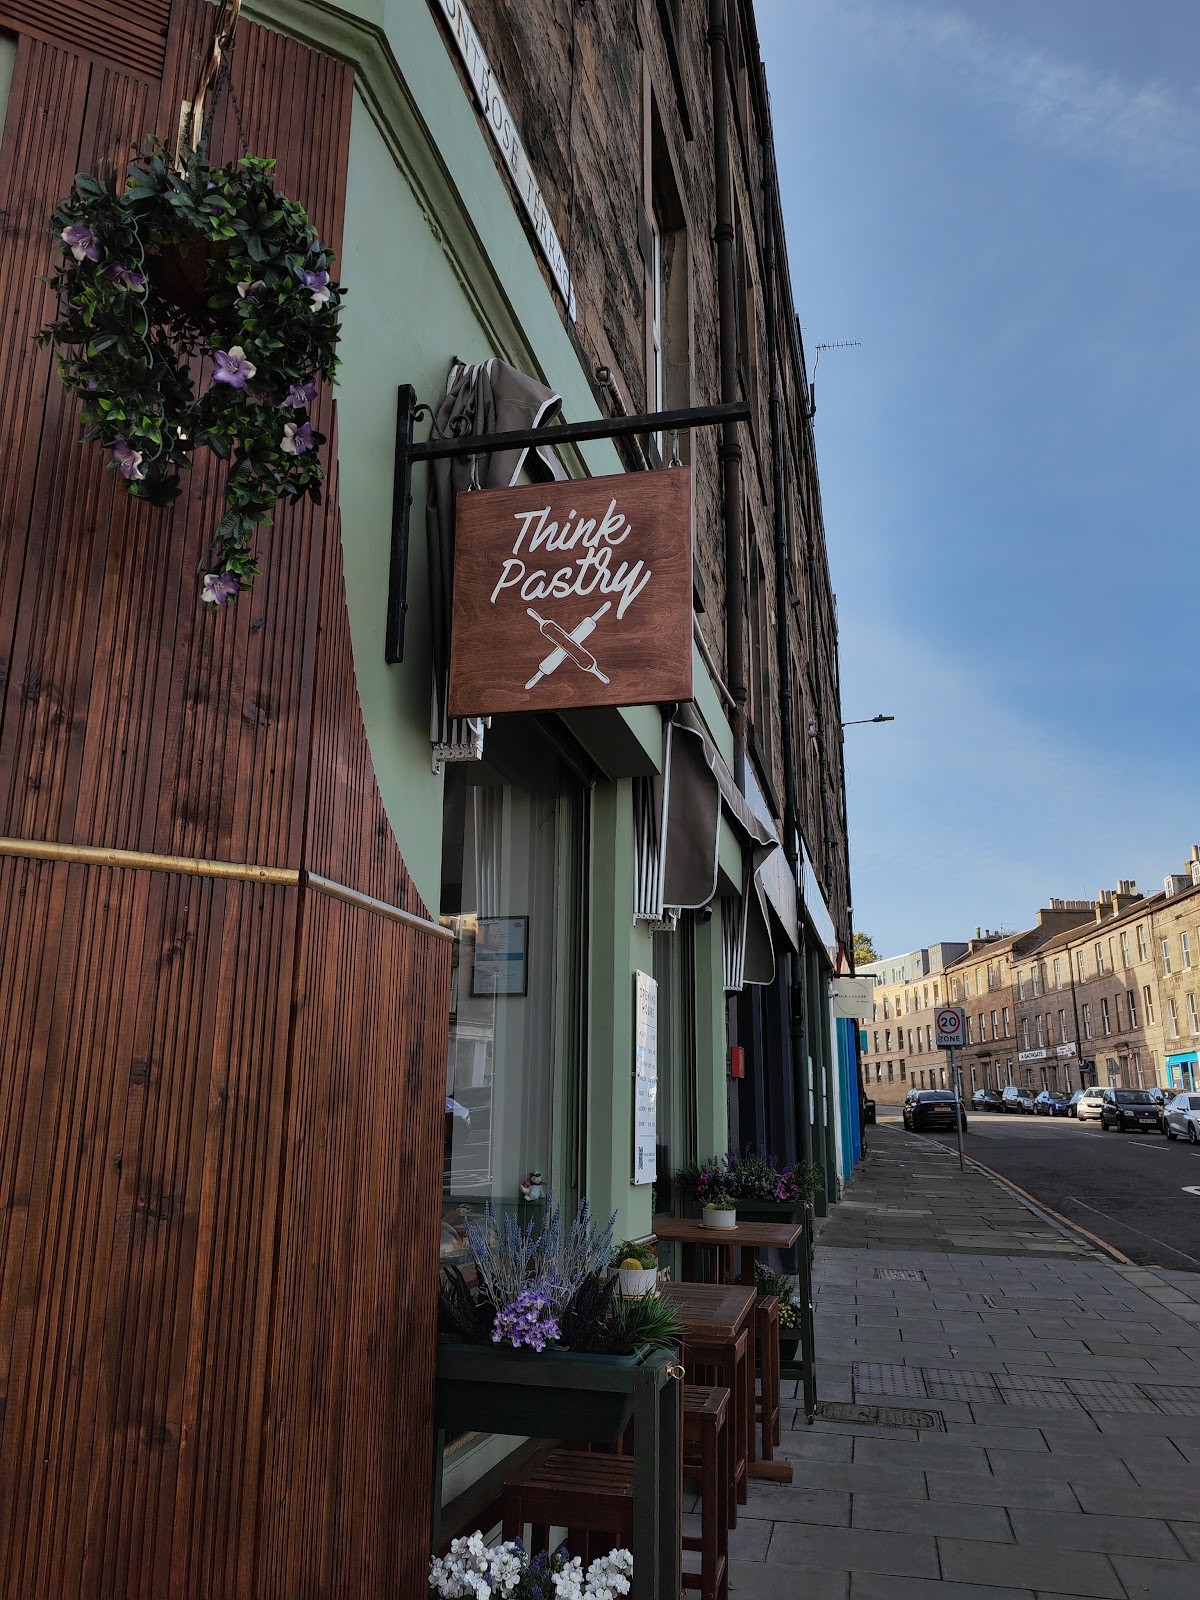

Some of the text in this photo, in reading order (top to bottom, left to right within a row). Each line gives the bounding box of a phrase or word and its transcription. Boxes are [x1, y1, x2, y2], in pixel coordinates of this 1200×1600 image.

[513, 498, 632, 555] Think
[490, 547, 651, 620] Pastry
[941, 1017, 957, 1027] 20
